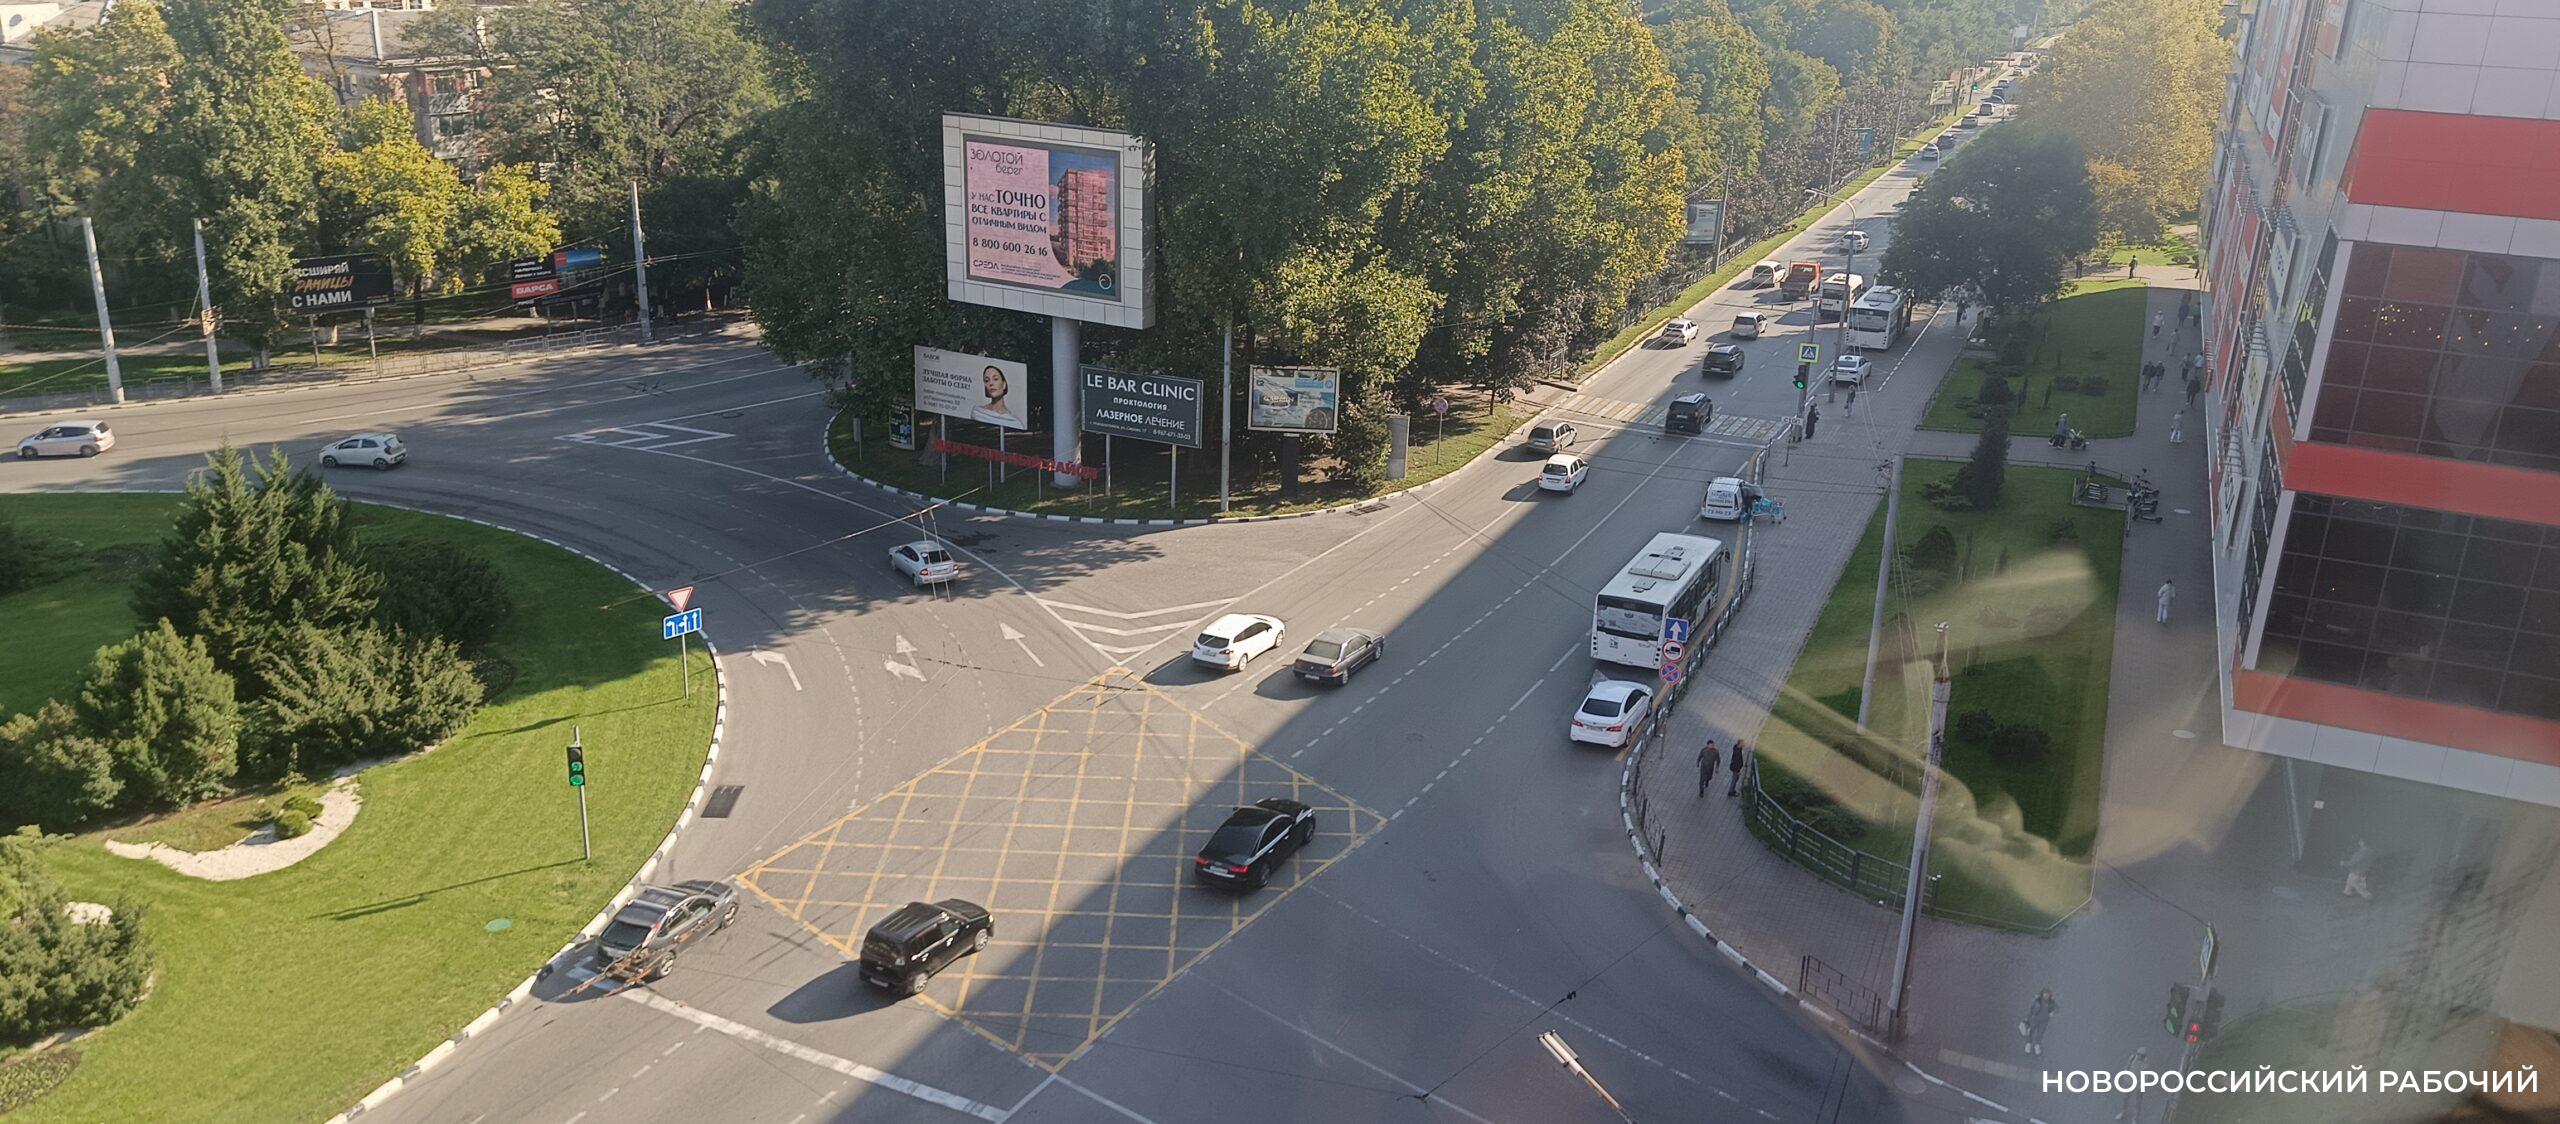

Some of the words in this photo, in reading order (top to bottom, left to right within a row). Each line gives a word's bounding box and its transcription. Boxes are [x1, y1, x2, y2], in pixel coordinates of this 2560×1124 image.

[970, 148, 1023, 165] ЗОЛОТОЙ
[971, 192, 977, 200] У
[979, 192, 994, 203] НАС
[995, 189, 1046, 209] ТОЧНО
[971, 203, 988, 214] ВСЕ
[991, 206, 1037, 220] КВАРТИРЫ
[1039, 212, 1047, 222] С
[971, 216, 1016, 230] ОТЛИЧНЫМ
[1017, 222, 1047, 234] ВИДОМ
[972, 237, 979, 247] 8
[981, 238, 1000, 250] 800
[1002, 241, 1021, 253] 600
[1024, 244, 1036, 255] 26
[1038, 246, 1048, 257] 16
[516, 283, 554, 295] БАРСА
[292, 296, 303, 308] С
[306, 290, 352, 306] НАМИ
[922, 376, 947, 387] ЗАБОТЫ
[953, 382, 971, 390] СЕБЕ!
[923, 369, 949, 379] ЛУЧШАЯ
[950, 373, 972, 383] ФОРМА
[1087, 374, 1103, 388] LE
[1108, 376, 1136, 393] BAR
[1141, 382, 1195, 401] CLINIC
[1113, 397, 1168, 411] ПРОКТОЛОГИЯ
[1096, 408, 1143, 424] ЛАЗЕРНОЕ
[1145, 416, 1185, 430] ЛЕЧЕНИЕ
